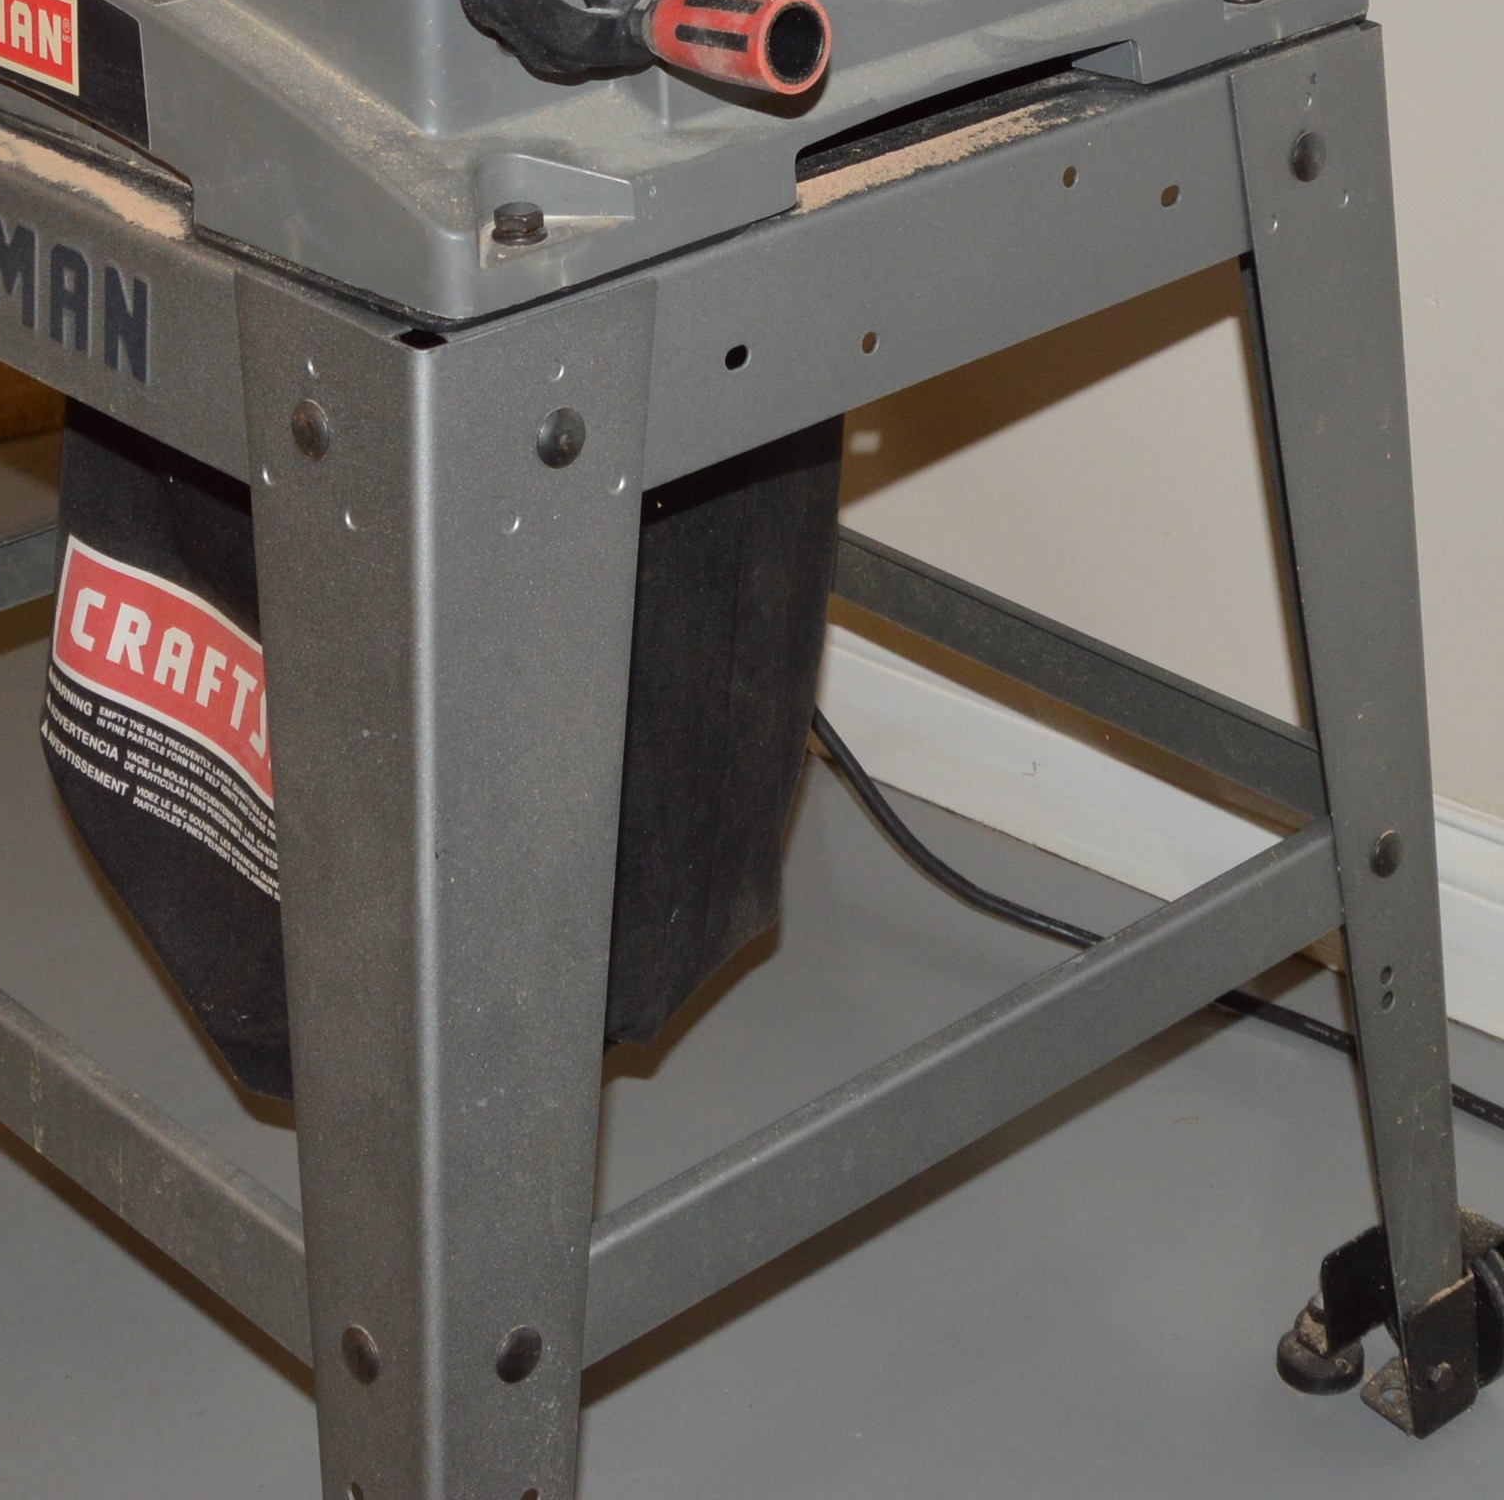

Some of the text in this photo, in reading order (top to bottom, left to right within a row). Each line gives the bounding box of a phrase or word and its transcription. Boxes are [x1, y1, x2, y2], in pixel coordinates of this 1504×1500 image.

[52, 672, 94, 717] WARNING
[98, 705, 128, 726] EMPTY
[128, 717, 146, 734] THE
[145, 726, 164, 743] BAG
[47, 730, 130, 797] AVERTISSEMENT
[136, 785, 160, 805] VIDEZ
[160, 798, 172, 811] LE
[171, 803, 188, 820] SAC
[50, 702, 119, 761] ADVERTENCIA
[126, 749, 151, 769] VACIE
[151, 761, 163, 775] LA
[162, 767, 189, 789] BOLSA
[96, 716, 107, 729] IN
[106, 721, 127, 738] FINE
[126, 730, 166, 756] PARTICLE
[165, 749, 189, 769] FORM
[188, 761, 205, 778] MAY
[123, 760, 136, 774] DE
[136, 766, 186, 799] PARTICULAS
[185, 791, 207, 812] FINAS
[132, 796, 182, 829] PARTICULES
